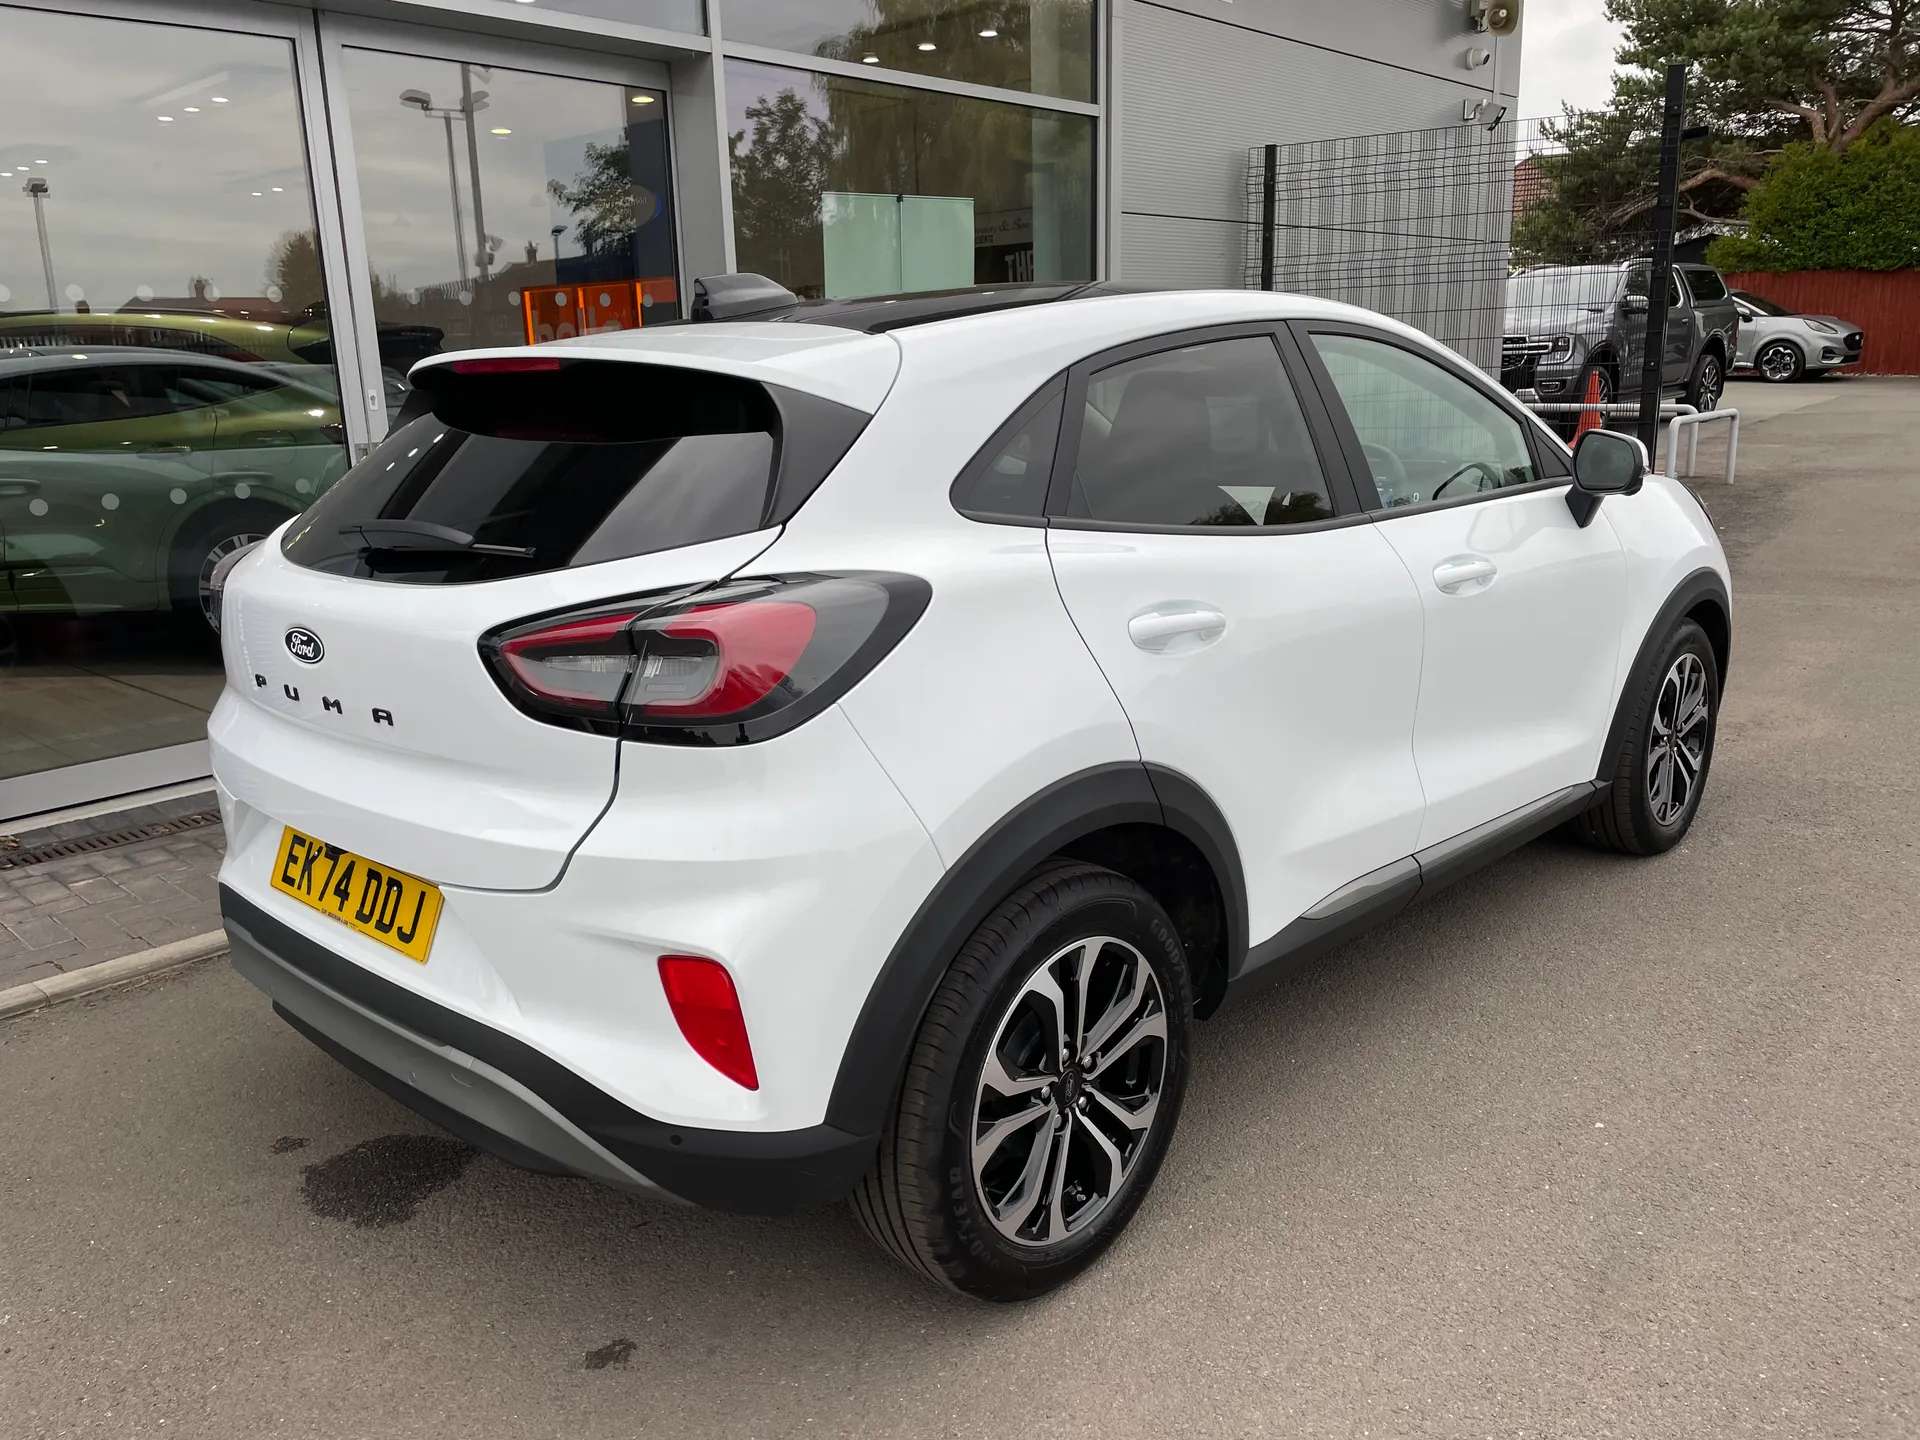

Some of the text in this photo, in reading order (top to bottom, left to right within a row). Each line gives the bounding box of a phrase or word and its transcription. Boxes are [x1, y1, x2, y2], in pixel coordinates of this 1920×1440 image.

[254, 673, 394, 726] PUMA
[281, 833, 427, 945] EK74 DDJ
